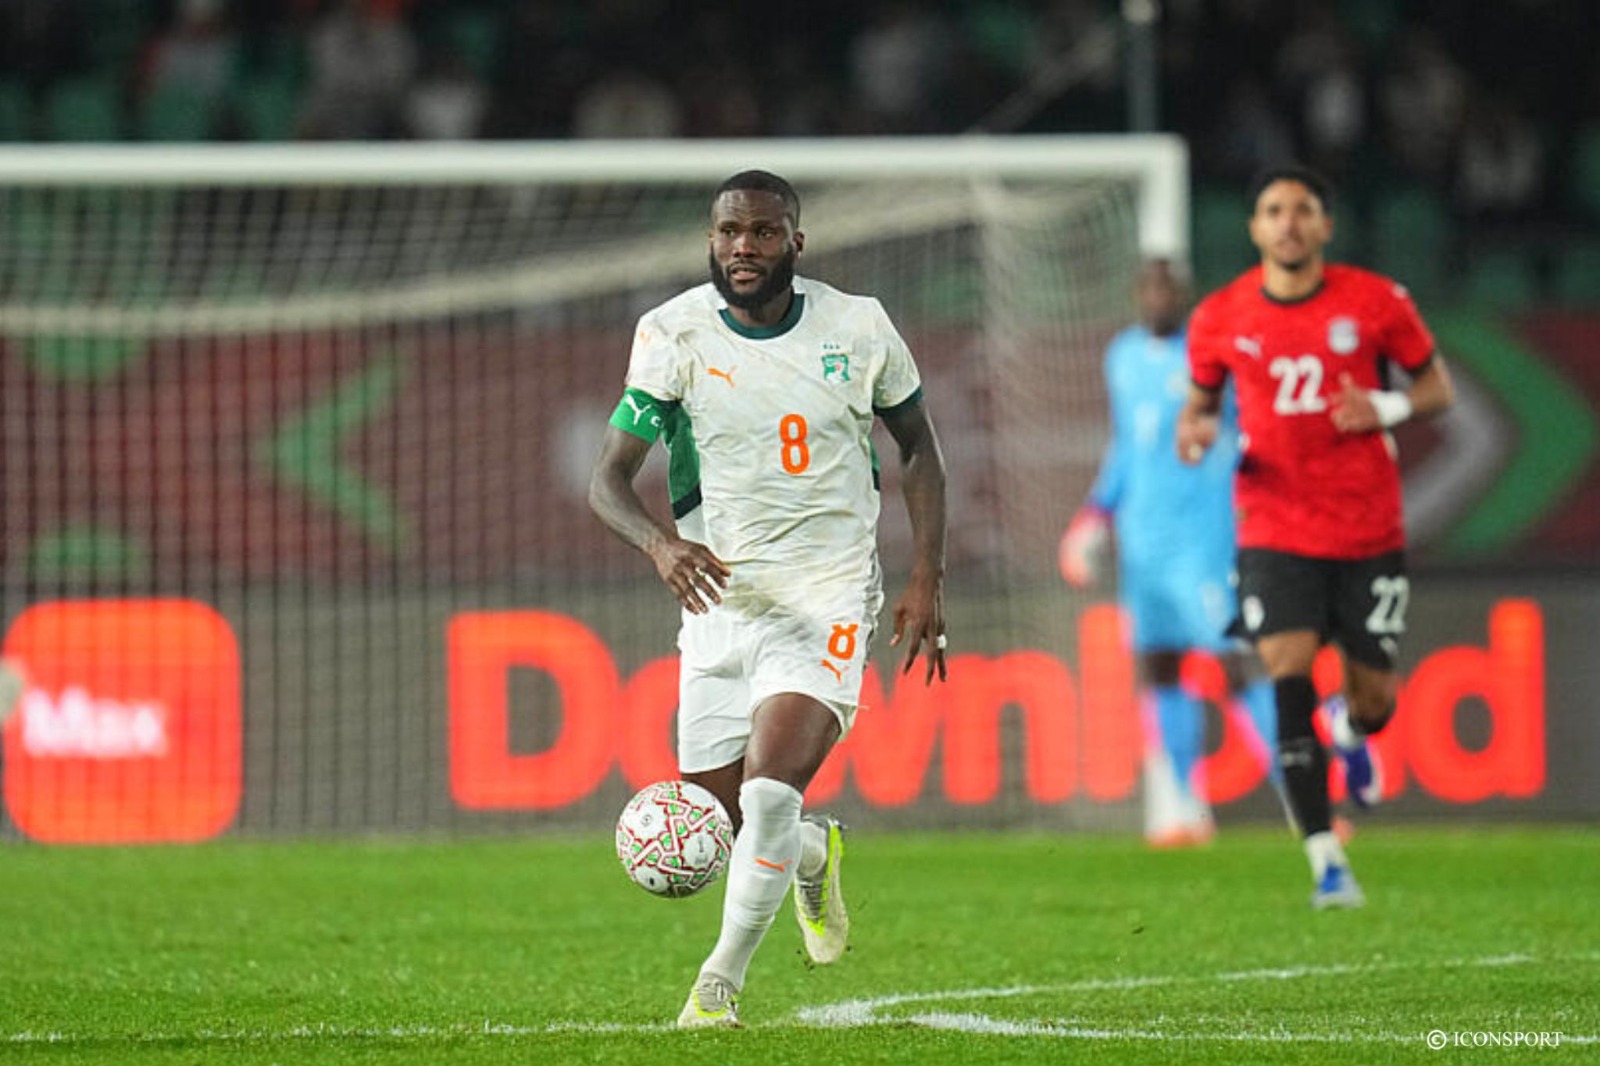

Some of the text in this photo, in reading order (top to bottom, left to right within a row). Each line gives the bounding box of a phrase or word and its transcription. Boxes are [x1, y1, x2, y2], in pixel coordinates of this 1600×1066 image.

[1269, 355, 1328, 415] 22
[778, 413, 811, 475] 8
[1365, 575, 1410, 634] 22
[827, 623, 859, 661] 8
